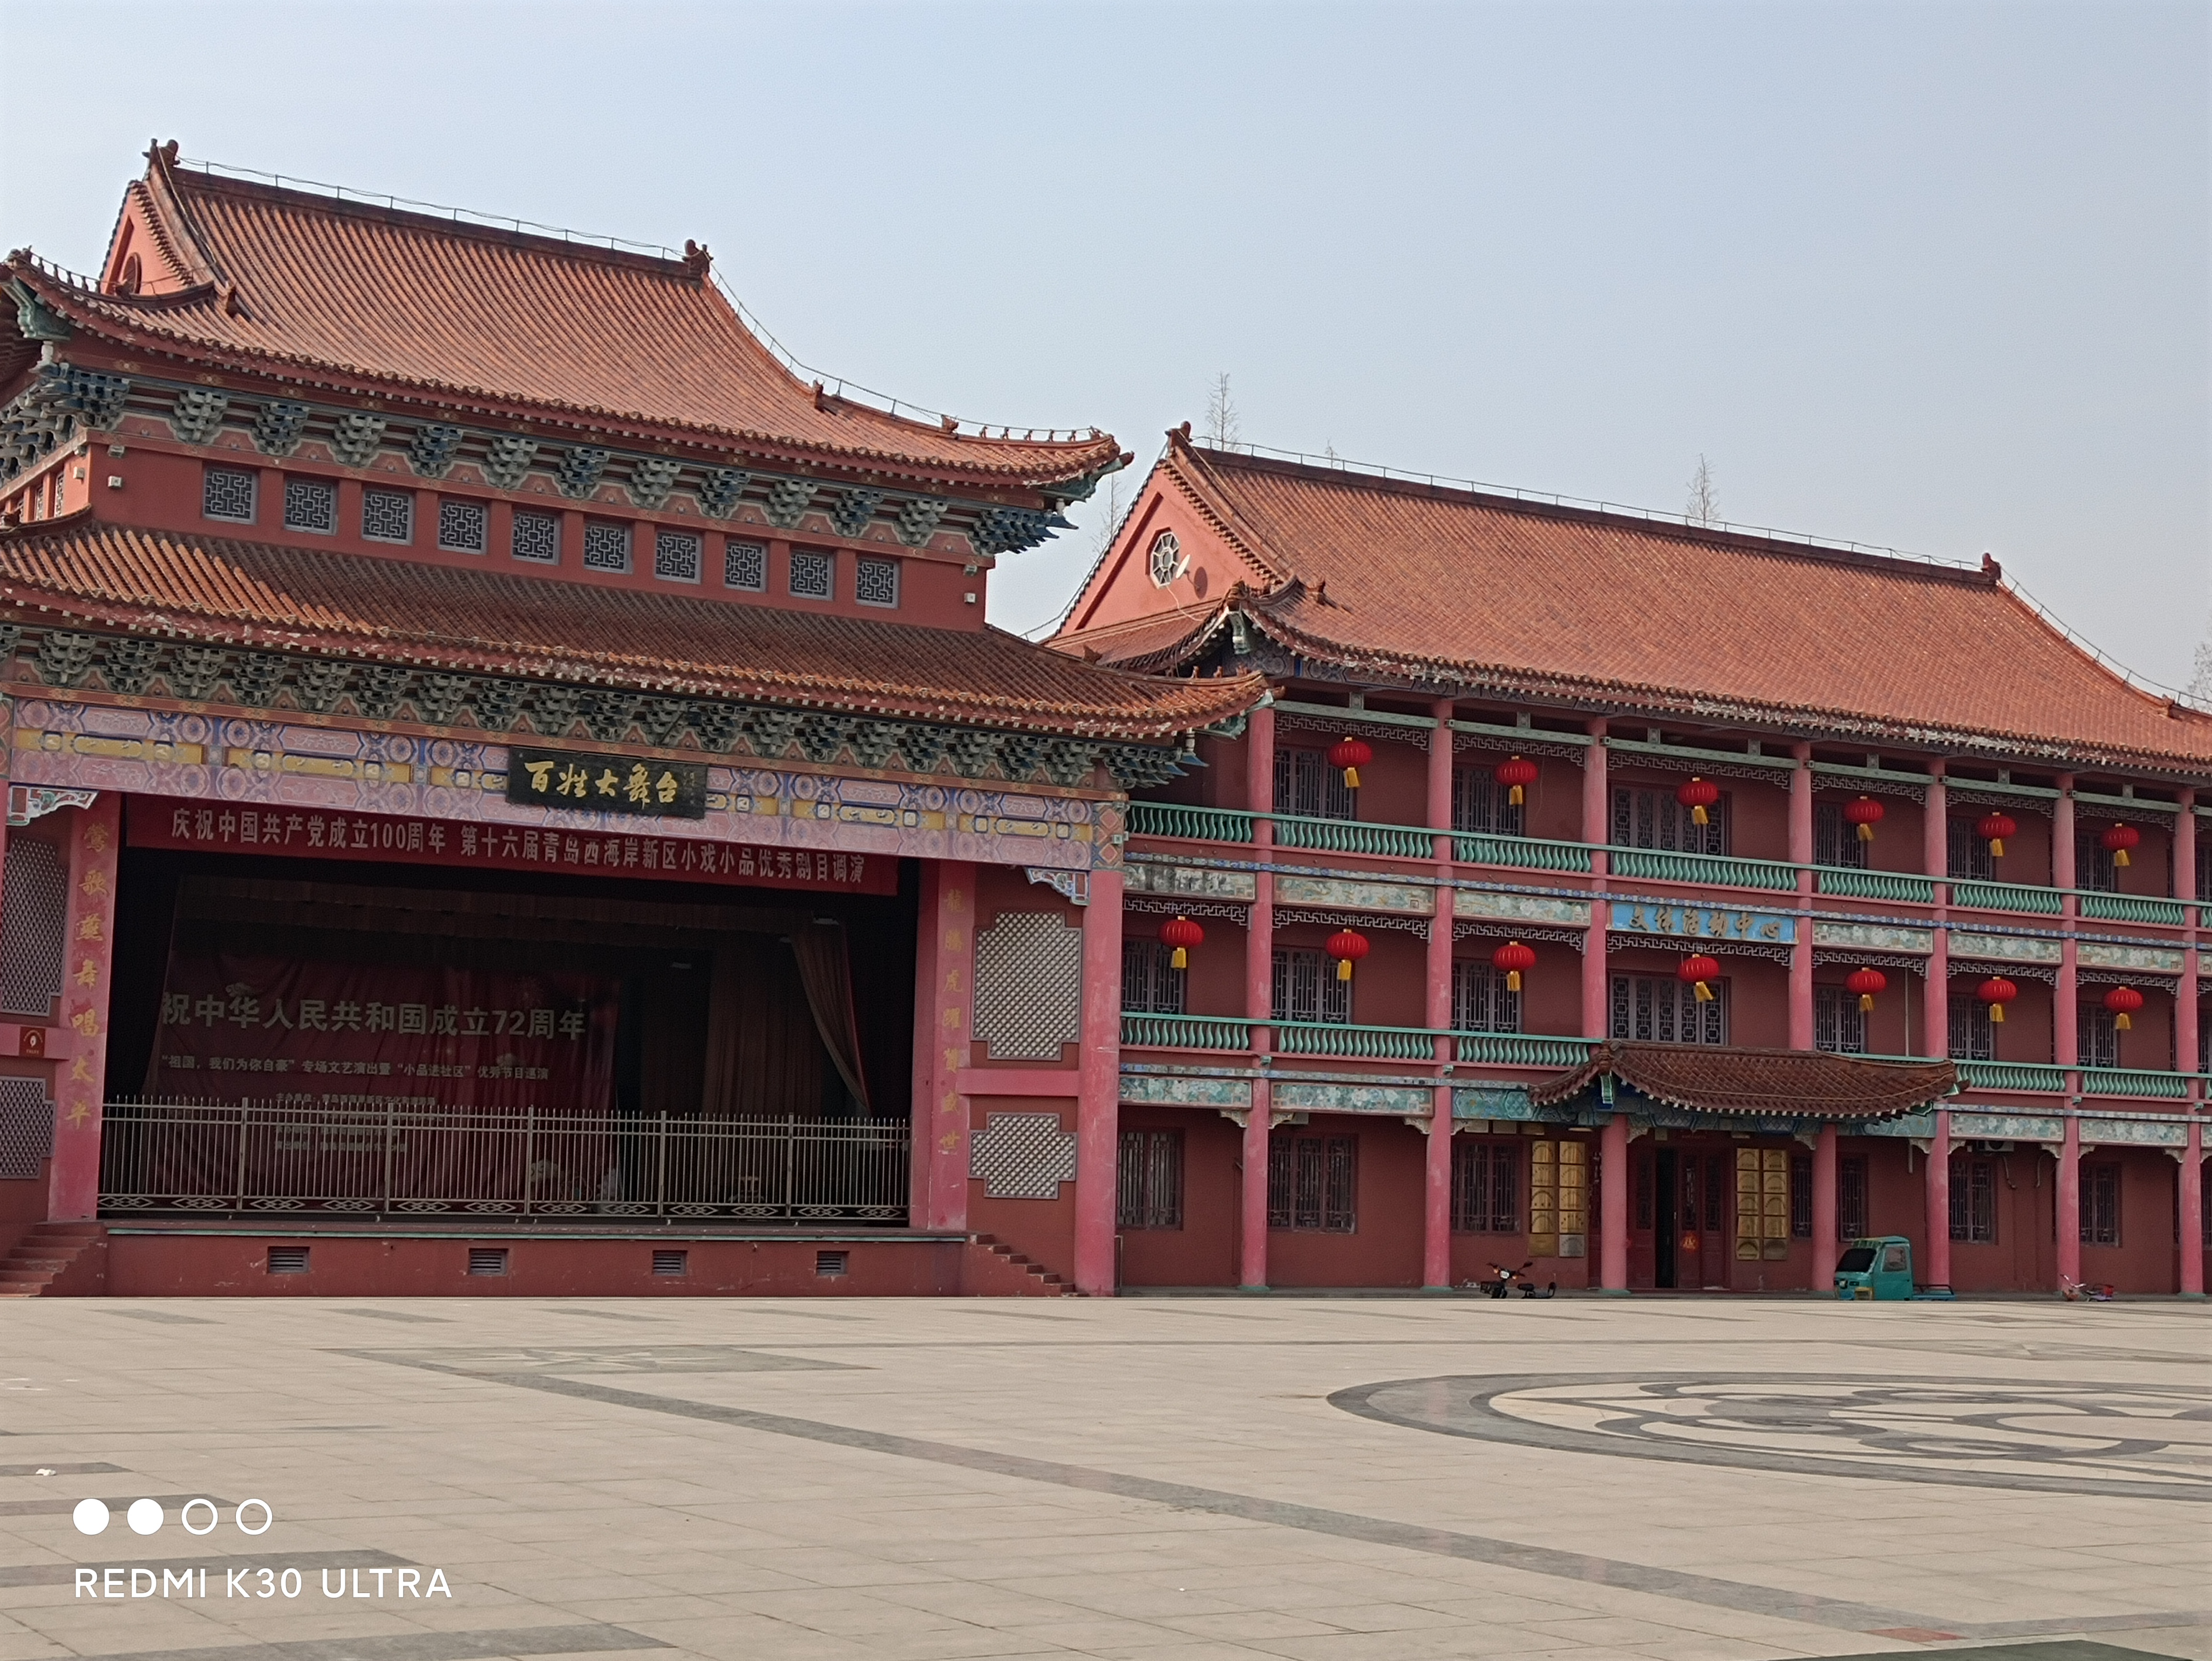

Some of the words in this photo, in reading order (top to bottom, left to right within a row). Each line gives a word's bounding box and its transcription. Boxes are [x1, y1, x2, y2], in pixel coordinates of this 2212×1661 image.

[524, 760, 678, 810] 百姓大舞台
[171, 808, 446, 854] 庆祝中国共产党成立100周年
[460, 825, 865, 884] 第十六届青岛西海岸新区小戏小品优秀剧目调演
